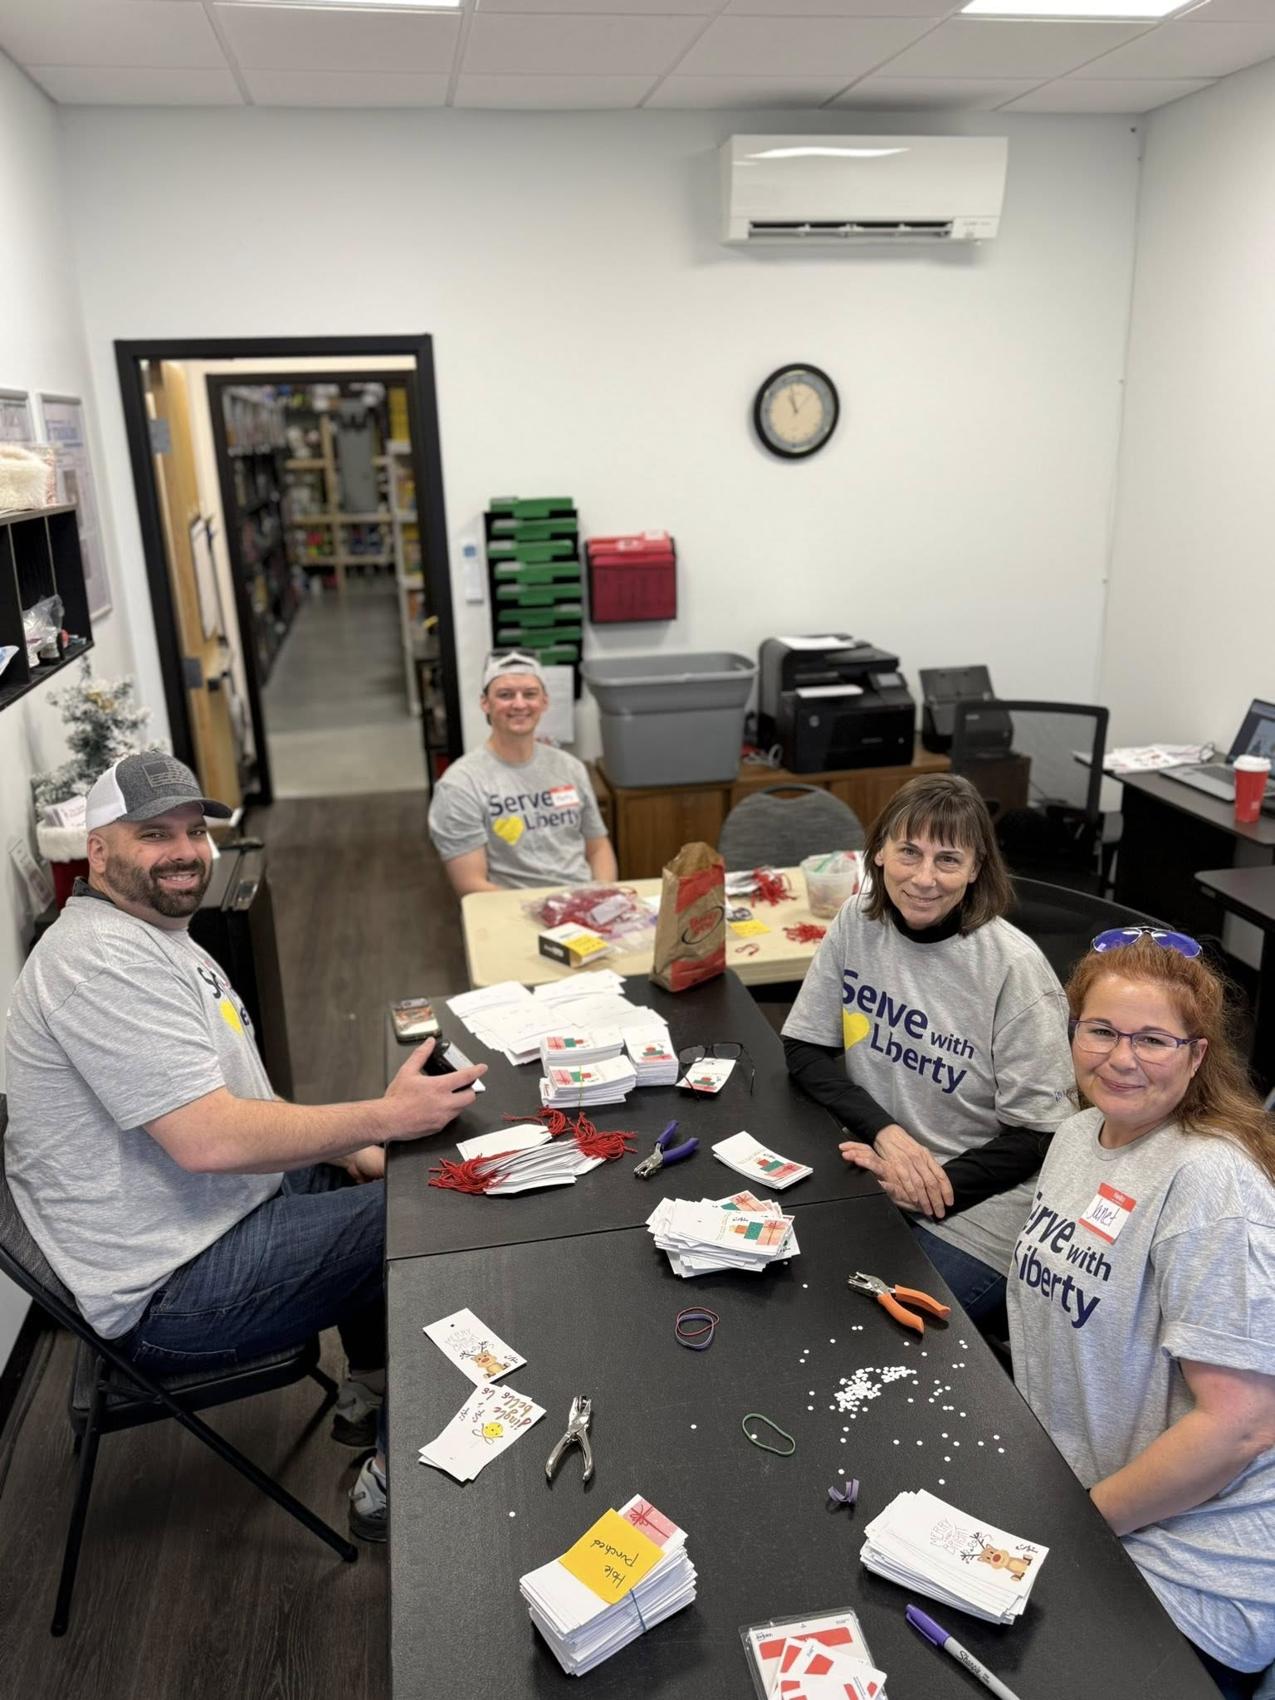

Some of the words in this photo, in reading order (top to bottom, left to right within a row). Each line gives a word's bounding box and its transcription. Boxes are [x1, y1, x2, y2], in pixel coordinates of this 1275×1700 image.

[490, 790, 554, 816] Serve
[870, 1022, 967, 1094] Lberty
[930, 1031, 975, 1060] with
[1023, 1191, 1076, 1254] rve
[1066, 1244, 1112, 1282] with
[604, 1564, 626, 1589] Hole
